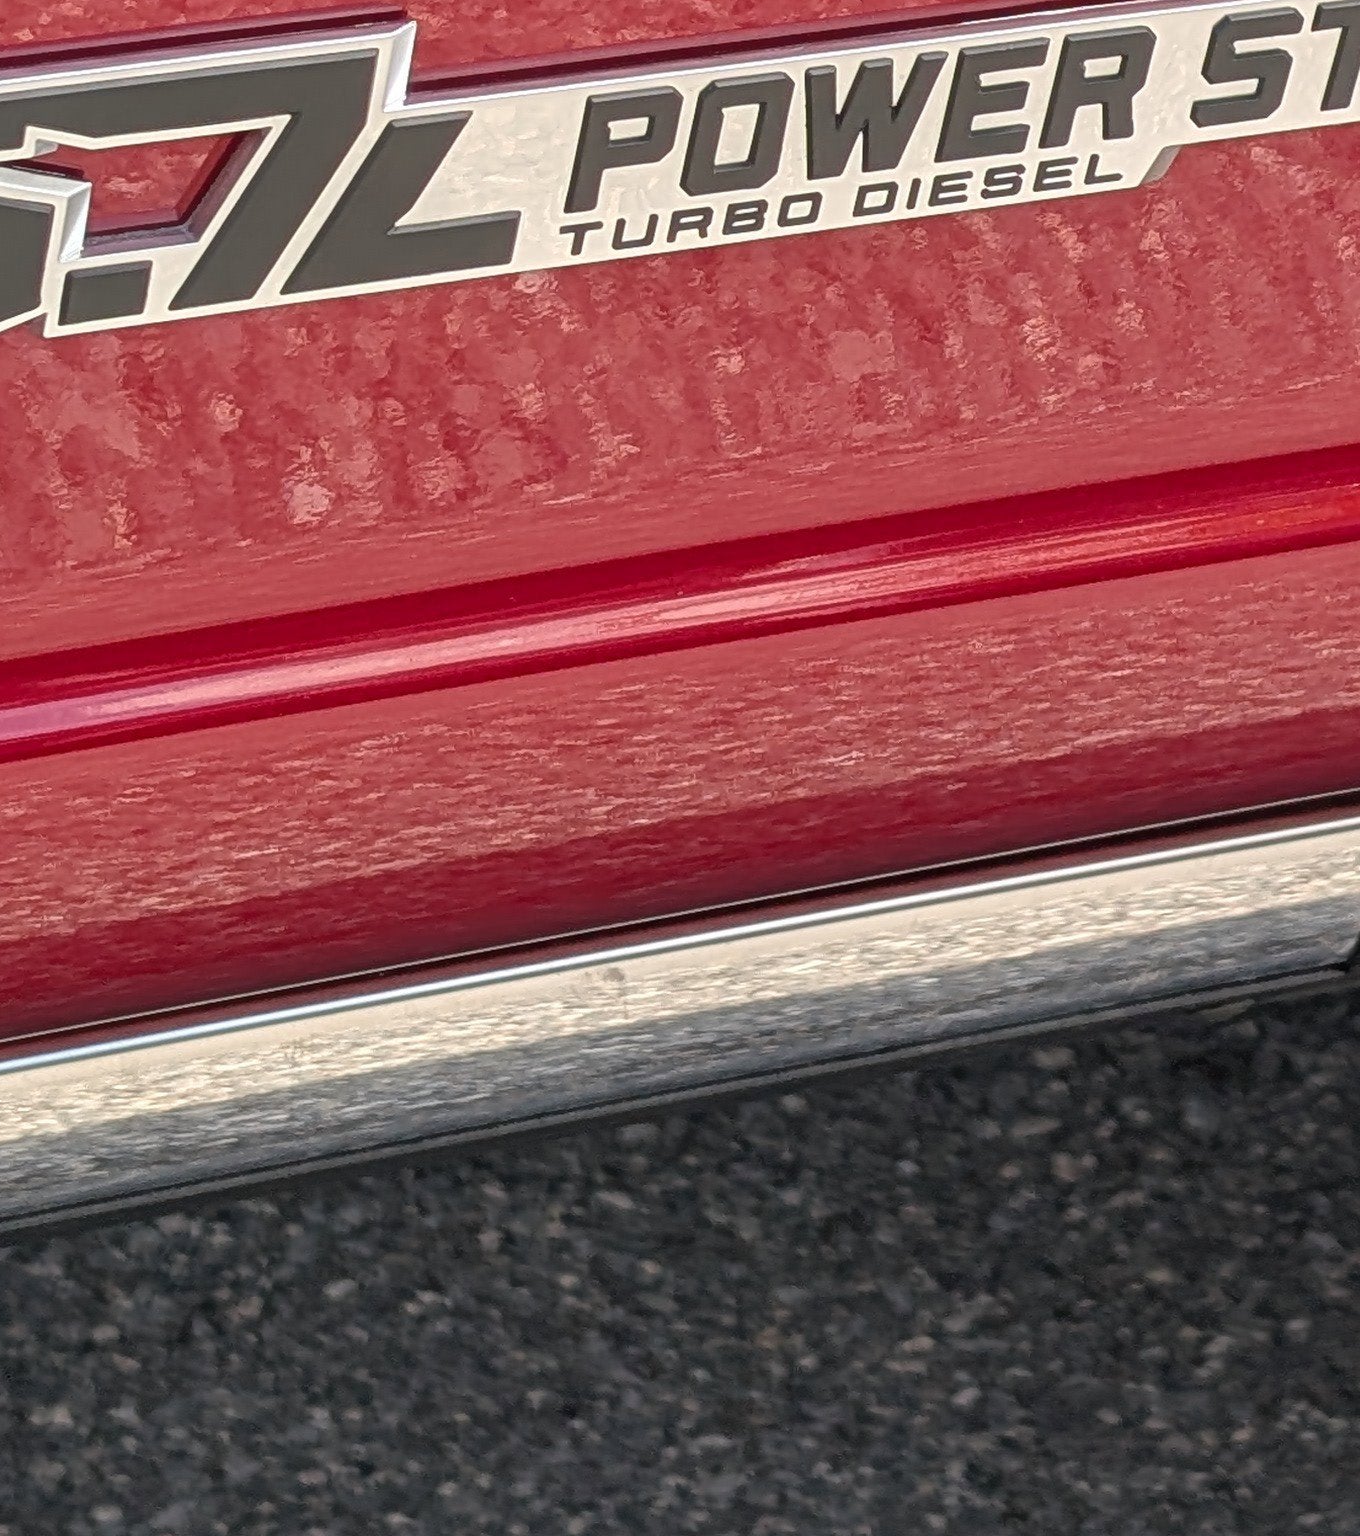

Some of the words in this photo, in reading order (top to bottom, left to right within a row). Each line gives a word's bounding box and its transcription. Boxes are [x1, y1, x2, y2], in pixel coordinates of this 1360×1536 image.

[564, 24, 1157, 212] POWER
[558, 194, 820, 257] TURBO
[853, 152, 1124, 217] DIESEL
